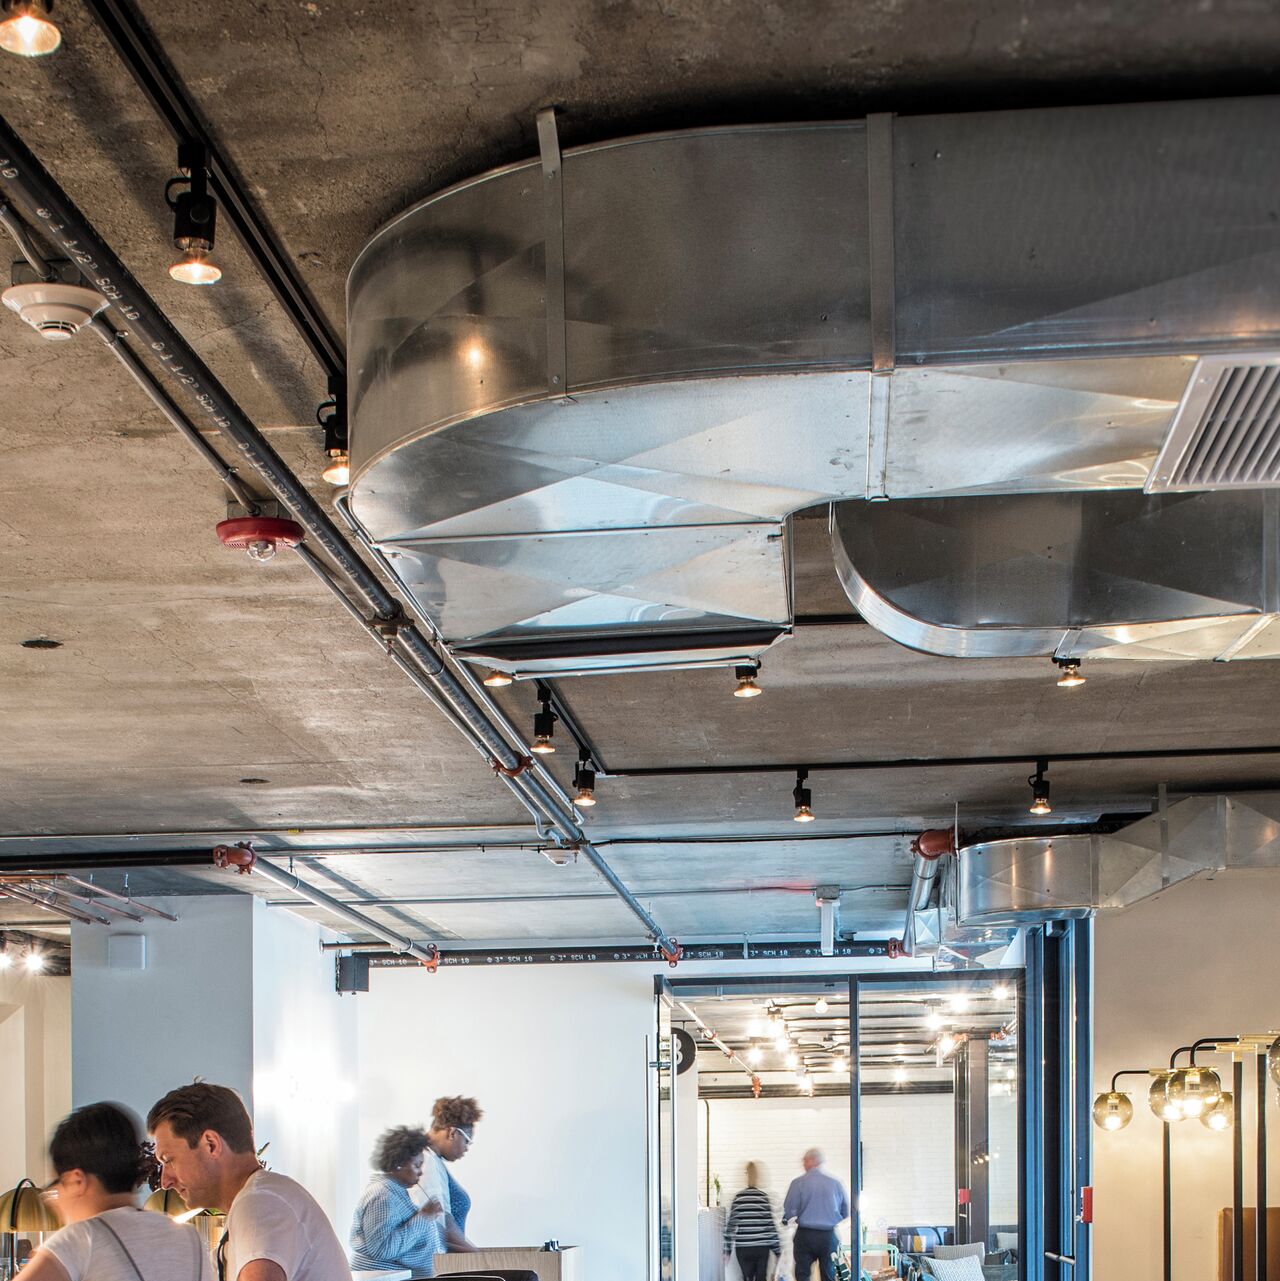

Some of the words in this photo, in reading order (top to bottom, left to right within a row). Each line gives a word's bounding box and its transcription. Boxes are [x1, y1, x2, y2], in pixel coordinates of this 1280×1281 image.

[49, 223, 65, 233] 1
[63, 239, 99, 271] 1/2"
[95, 277, 123, 301] SCH
[119, 304, 141, 321] 10
[196, 393, 217, 413] SCH
[214, 416, 231, 428] 10
